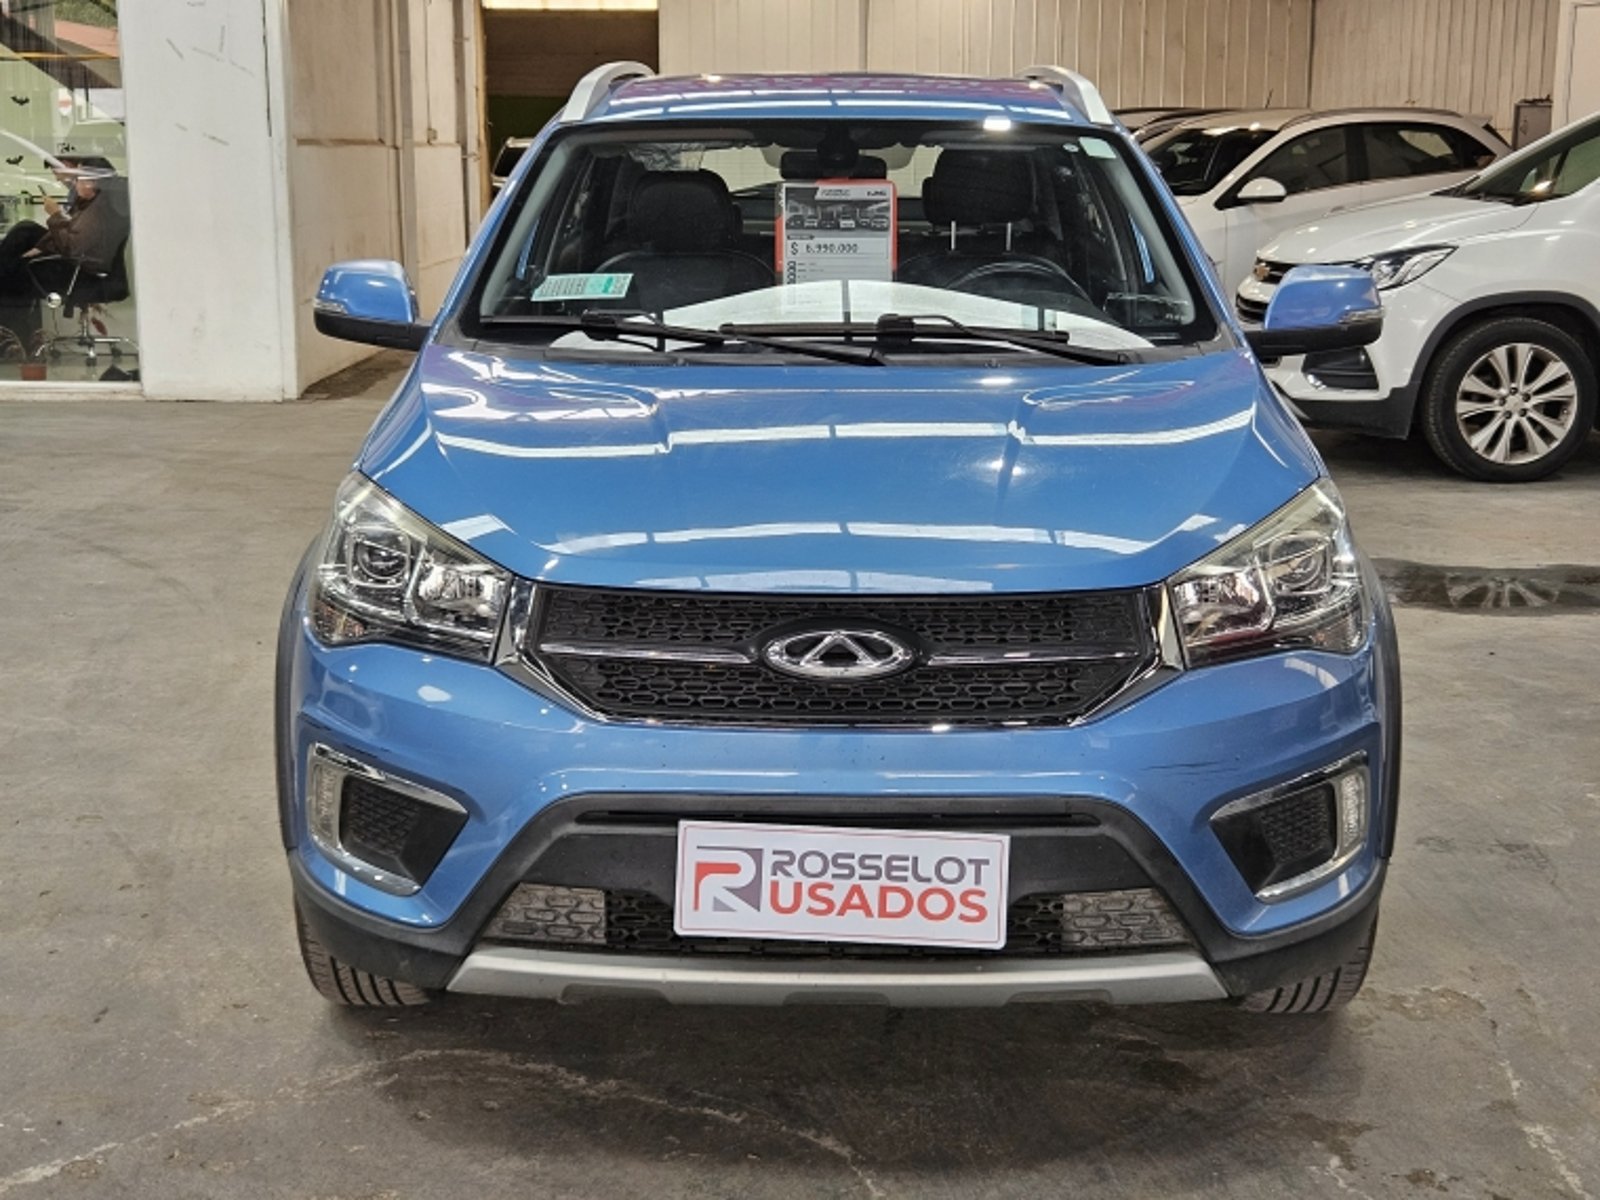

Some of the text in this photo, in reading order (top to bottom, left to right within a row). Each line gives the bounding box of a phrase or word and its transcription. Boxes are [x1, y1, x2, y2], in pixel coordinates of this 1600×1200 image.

[790, 241, 799, 256] $
[770, 849, 990, 885] ROSSELOT
[769, 880, 988, 923] USADOS
